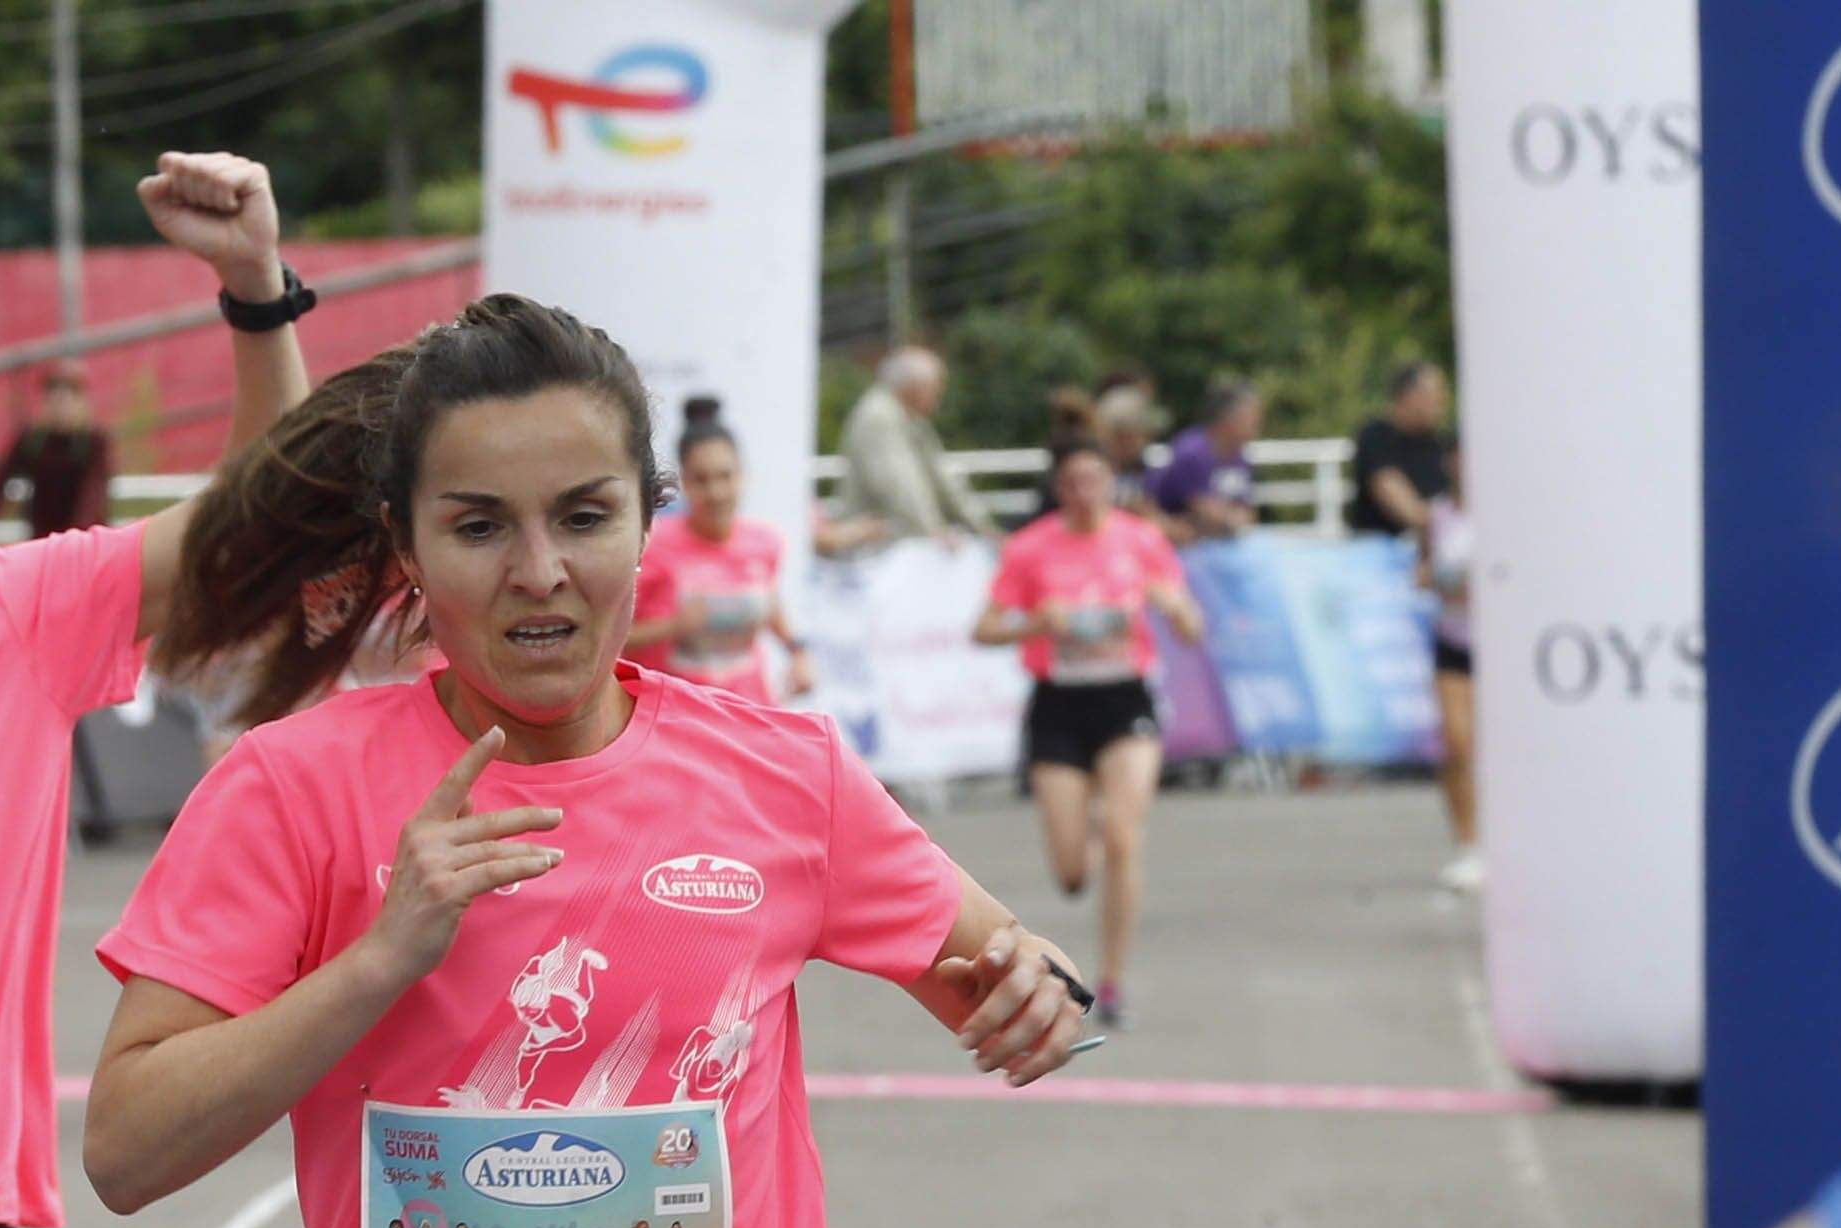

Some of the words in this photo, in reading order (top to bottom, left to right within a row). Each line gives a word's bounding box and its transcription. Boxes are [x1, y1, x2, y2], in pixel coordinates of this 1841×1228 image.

[1512, 101, 1702, 188] OYS
[1532, 619, 1705, 707] OYS
[654, 874, 757, 902] ASTURIANA
[385, 1140, 439, 1161] SUMA
[661, 1127, 692, 1153] 20
[474, 1158, 614, 1188] ASTURIANA
